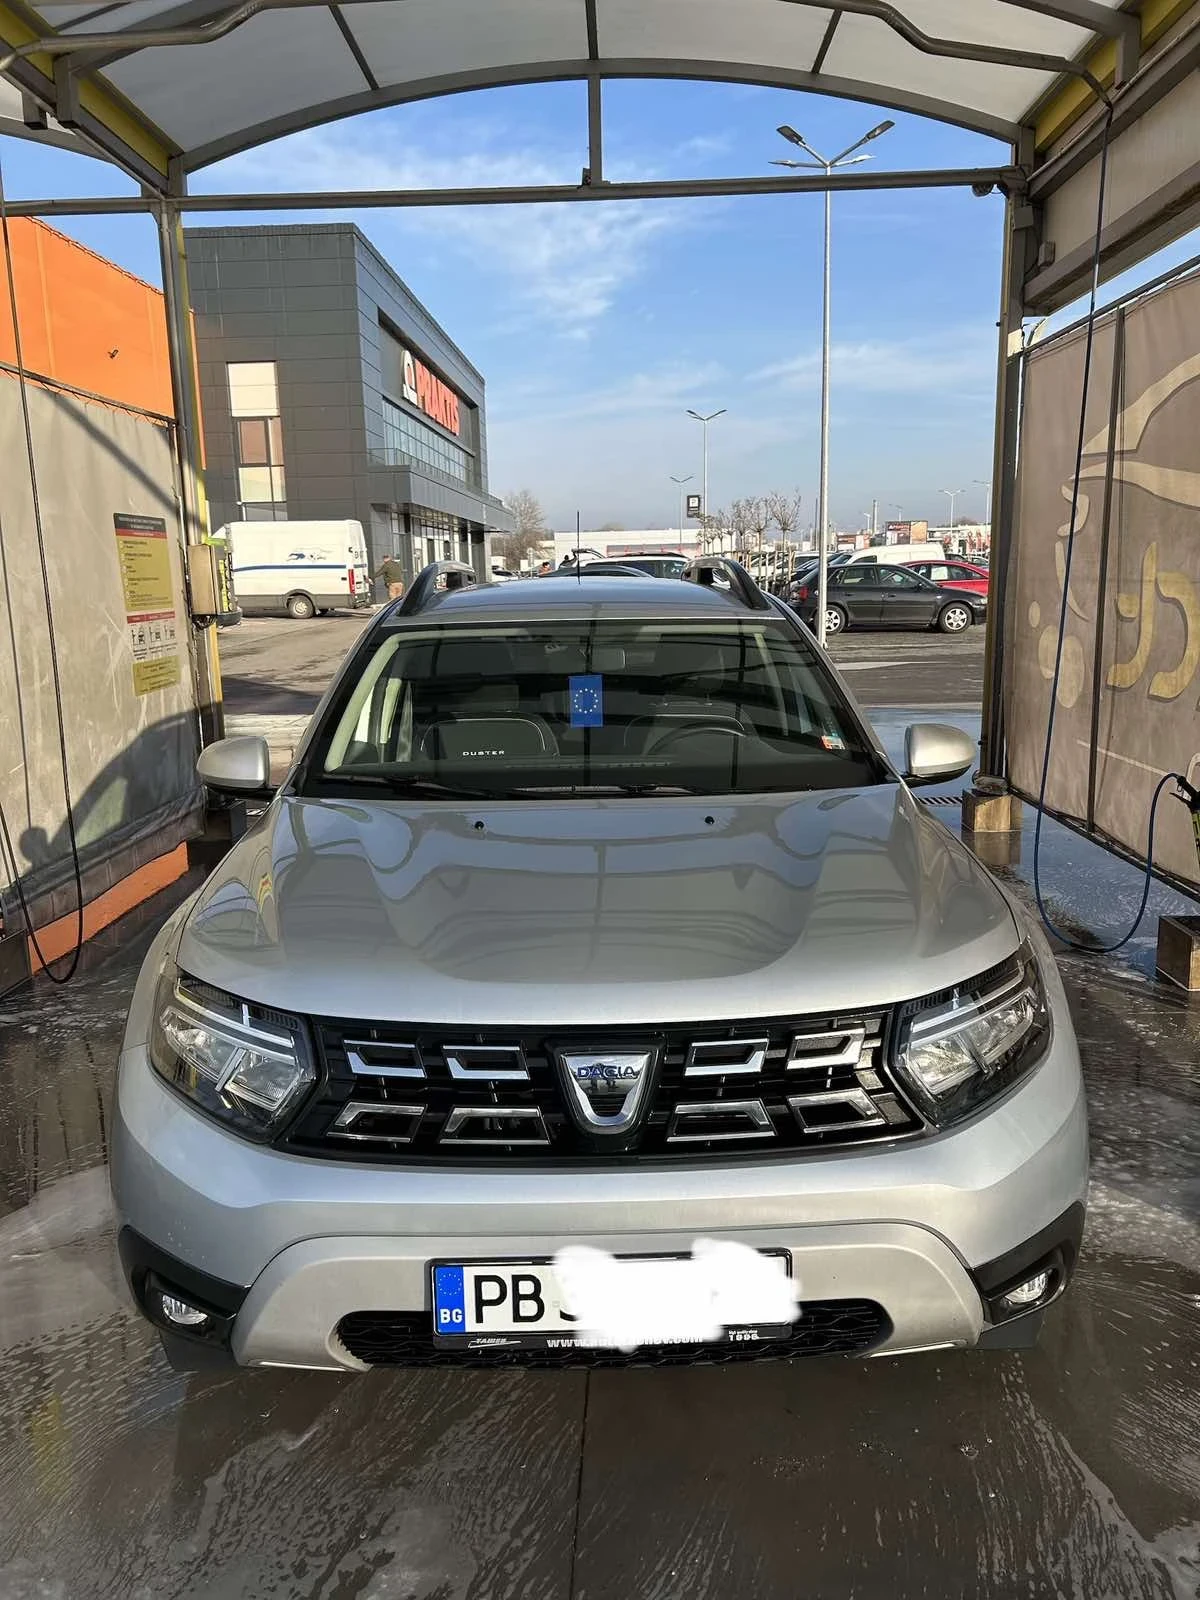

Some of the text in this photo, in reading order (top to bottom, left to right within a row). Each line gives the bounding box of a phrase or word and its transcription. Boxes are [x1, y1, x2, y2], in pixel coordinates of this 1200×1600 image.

[415, 358, 460, 436] PRAKTIS
[577, 1065, 636, 1078] DACIA
[474, 1274, 545, 1324] PB
[439, 1308, 463, 1324] BG
